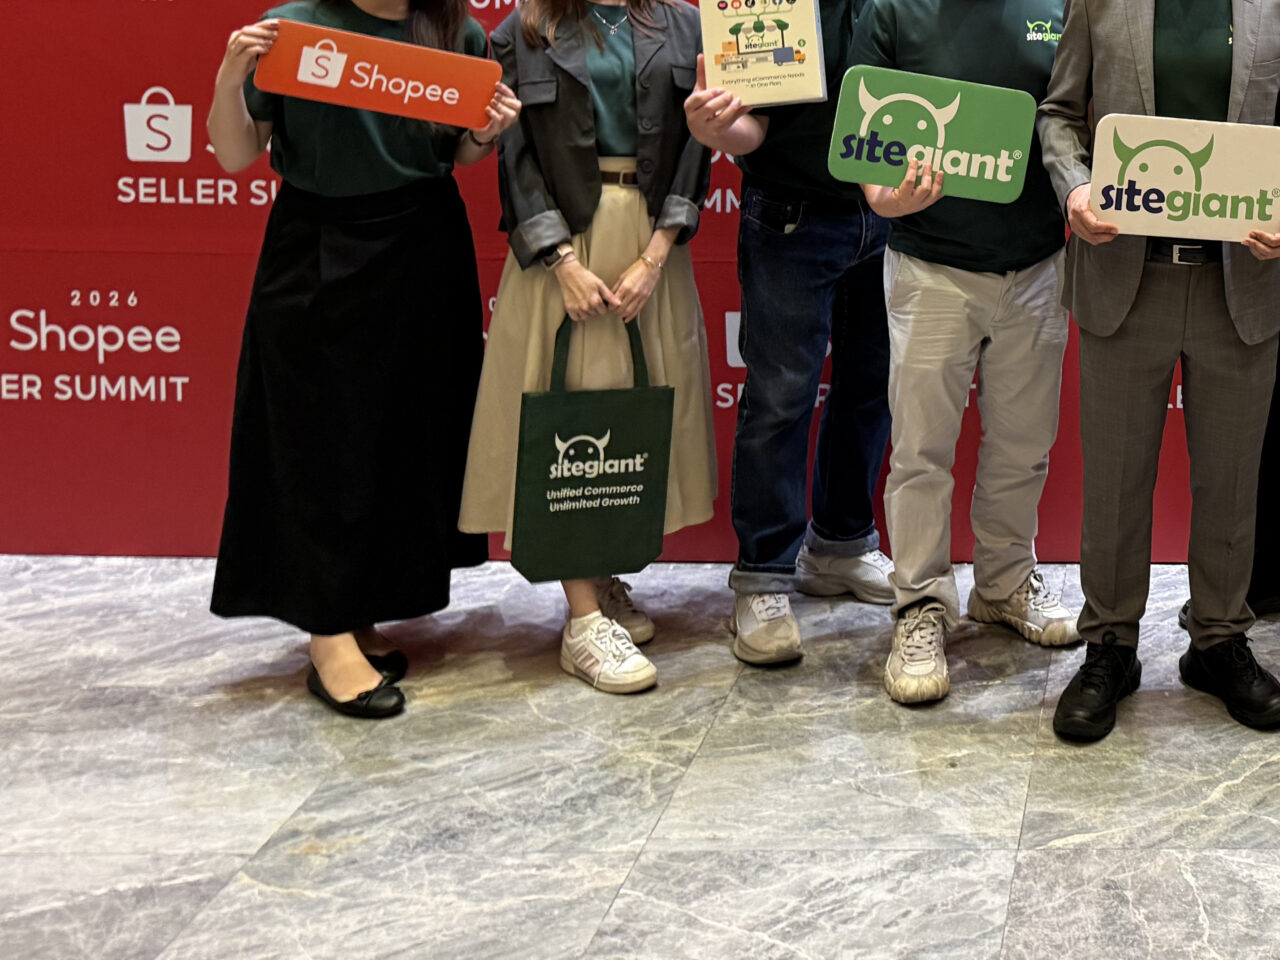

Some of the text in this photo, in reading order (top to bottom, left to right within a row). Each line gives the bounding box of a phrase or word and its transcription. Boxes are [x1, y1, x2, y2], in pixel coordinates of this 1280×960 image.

[350, 61, 460, 105] Shopee
[117, 176, 238, 205] SELLER
[70, 289, 138, 307] 2026
[9, 308, 182, 364] Shopee
[54, 373, 190, 402] SUMMIT
[546, 484, 644, 500] Unified Commerce
[549, 495, 640, 513] Unlimited Growth
